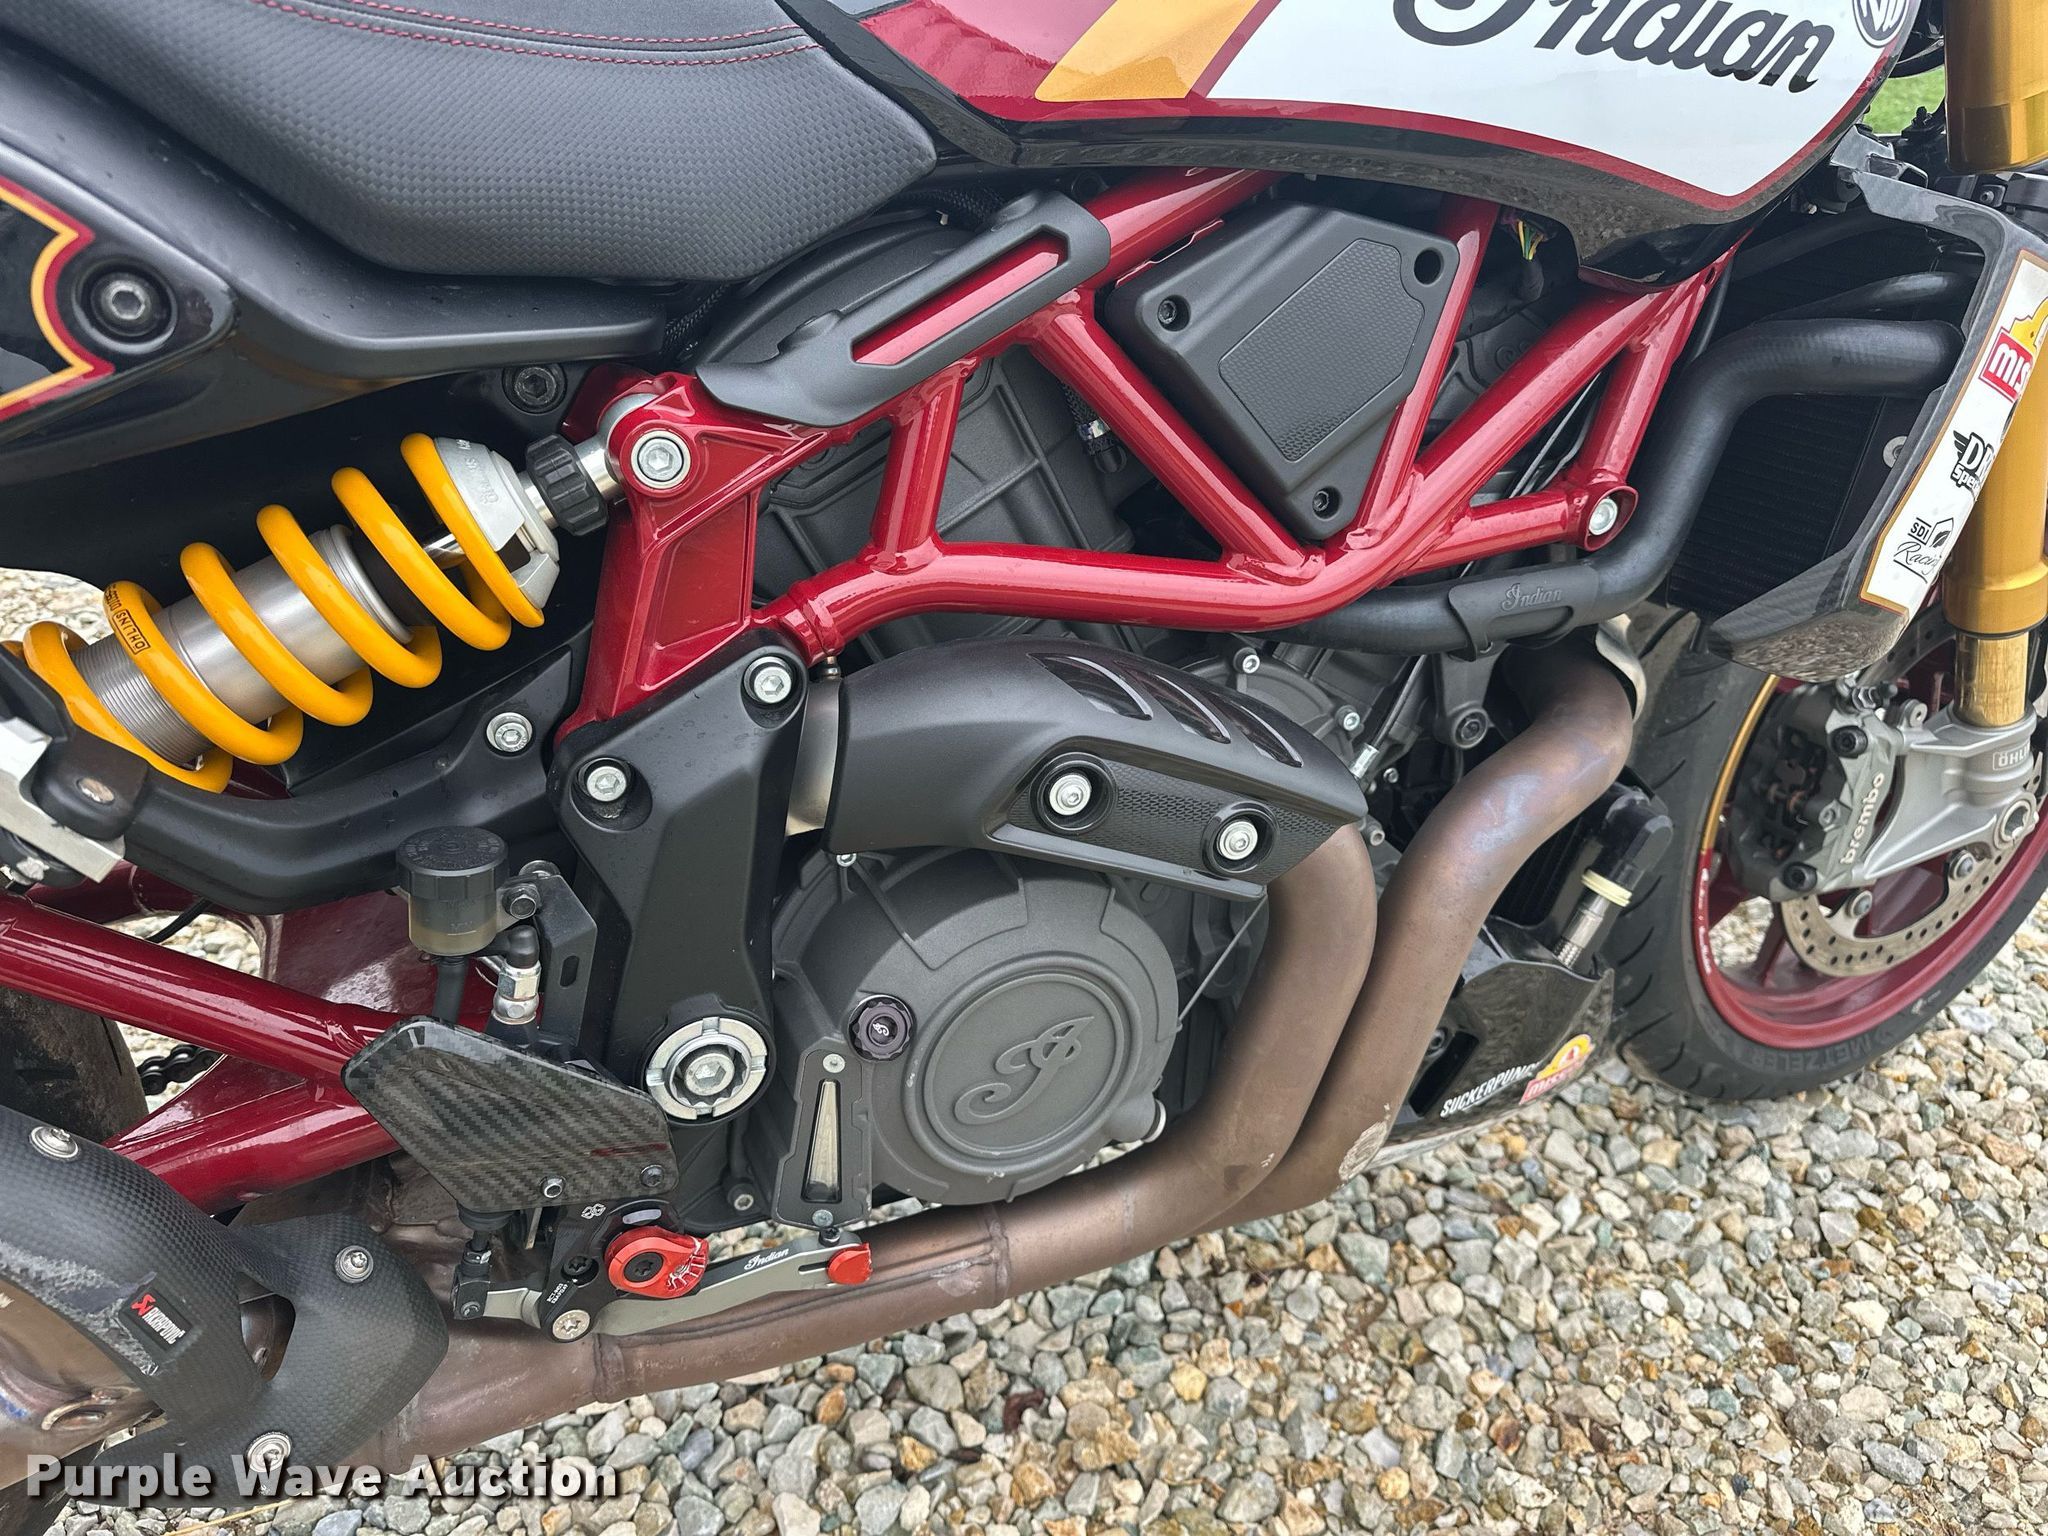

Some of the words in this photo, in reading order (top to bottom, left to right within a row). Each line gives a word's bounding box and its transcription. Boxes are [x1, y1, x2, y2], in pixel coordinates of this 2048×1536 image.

[1910, 522, 1930, 541] SDI
[1500, 582, 1562, 612] Indian
[1840, 772, 1885, 865] brembo
[743, 1248, 789, 1271] Indian
